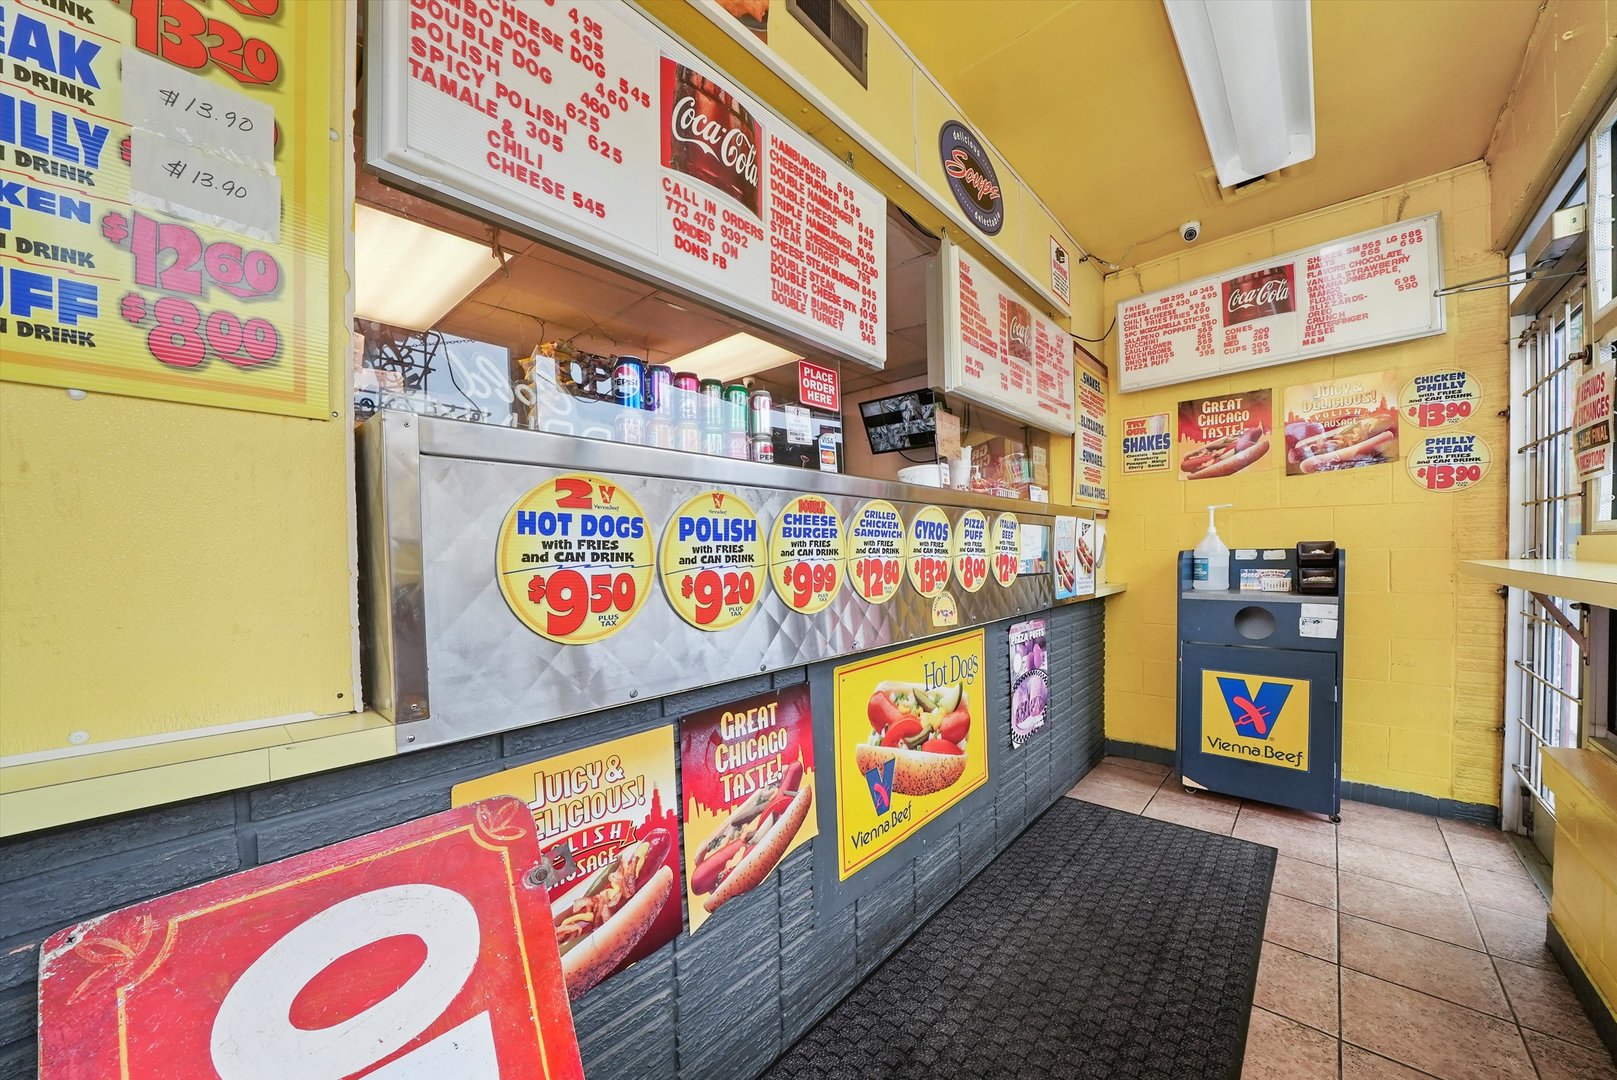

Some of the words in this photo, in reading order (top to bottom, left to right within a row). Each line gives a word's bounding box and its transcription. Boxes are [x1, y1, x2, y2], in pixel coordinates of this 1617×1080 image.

[568, 8, 602, 40] 495
[500, 20, 540, 57] DOG
[570, 28, 604, 59] 495
[411, 11, 500, 77] POLISH
[566, 102, 600, 132] 625
[513, 49, 552, 84] DOG
[13, 64, 95, 106] DRINK
[570, 45, 605, 78] DOG
[619, 78, 651, 108] 545
[408, 57, 498, 119] TAMALE
[526, 120, 563, 152] 305
[411, 36, 485, 88] SPICY
[496, 82, 567, 135] POLISH
[588, 134, 623, 164] 625
[159, 88, 253, 133] $13.90
[487, 130, 543, 170] CHILI
[15, 149, 96, 187] DRINK
[771, 134, 827, 182] HAMBURGER
[837, 182, 854, 200] 665
[945, 149, 1001, 201] Soups
[162, 160, 248, 200] $13.90
[487, 152, 565, 200] CHEESE
[572, 191, 606, 218] 545
[662, 177, 699, 207] CALL
[704, 200, 716, 216] IN
[722, 209, 764, 241] ORDERS
[770, 163, 805, 195] DOUBLE
[807, 187, 853, 226] HAMBURGER
[858, 222, 874, 239] 845
[771, 193, 802, 221] TRIPLE
[843, 200, 860, 218] 695
[665, 196, 688, 218] 773
[693, 211, 716, 231] 476
[721, 223, 748, 249] 9392
[771, 178, 805, 209] DOUBLE
[806, 202, 837, 229] CHEESE
[858, 235, 872, 250] 895
[673, 218, 712, 247] ORDER
[722, 241, 738, 259] ON
[1362, 240, 1381, 250] 565
[1400, 229, 1421, 240] 685
[1400, 236, 1423, 247] 695
[16, 237, 96, 269] DRINK
[674, 234, 708, 262] DONS
[712, 252, 727, 270] FB
[805, 239, 839, 268] BURGER
[770, 249, 807, 278] DOUBLE
[862, 298, 876, 313] 970
[770, 262, 807, 290] DOUBLE
[811, 283, 842, 307] CHEESE
[1309, 287, 1341, 299] MANGO
[771, 276, 808, 305] TURKEY
[811, 296, 844, 321] BURGER
[860, 320, 874, 335] 815
[1123, 309, 1150, 320] CHEESE
[1152, 303, 1174, 313] FRIES
[1125, 303, 1147, 313] FRIES
[1308, 308, 1332, 319] OREO
[772, 289, 807, 315] DOUBLE
[811, 307, 844, 331] TURKEY
[861, 331, 876, 346] 945
[1183, 313, 1210, 324] STICKS
[1305, 313, 1369, 332] BUTTERFINGER
[1306, 311, 1346, 325] CRUNCH
[17, 321, 97, 348] DRINK
[1162, 324, 1197, 336] POPPERS
[1225, 324, 1253, 336] CONES
[1304, 327, 1335, 338] RESEE
[1124, 341, 1172, 355] CAULIFLOWER
[1125, 347, 1172, 360] MUSHROOMS
[1224, 345, 1247, 355] CUPS
[1125, 357, 1148, 367] ONION
[1150, 352, 1175, 361] RINGS
[1125, 363, 1148, 372] PIZZA
[803, 367, 833, 383] PLACE
[1414, 372, 1466, 385] CHICKEN
[802, 379, 835, 395] ORDER
[1313, 384, 1351, 400] JUICY
[1416, 380, 1467, 393] PHILLY
[807, 391, 832, 405] HERE
[1202, 398, 1243, 414] GREAT
[1302, 390, 1377, 413] DELICIOUS!
[1198, 410, 1250, 427] CHICAGO
[1314, 408, 1362, 421] POLISH
[1126, 420, 1147, 428] TRY
[1200, 422, 1245, 439] TASTE!
[821, 437, 834, 445] VISA
[1123, 432, 1171, 454] SHAKES
[1425, 435, 1476, 446] PHILLY
[1591, 424, 1609, 445] FINAL
[1425, 444, 1474, 455] STEAK
[555, 478, 593, 509] 2
[798, 499, 827, 514] DOUBLE
[864, 510, 896, 520] GRILLED
[517, 511, 573, 536] HOT
[580, 514, 644, 539] DOGS
[783, 513, 836, 526] CHEESE
[859, 519, 899, 530] CHICKEN
[964, 518, 985, 529] PIZZA
[1000, 519, 1017, 530] ITALIAN
[678, 516, 757, 542] POLISH
[782, 526, 838, 539] BURGER
[854, 528, 902, 539] SANDWICH
[915, 520, 949, 541] GYROS
[964, 530, 983, 540] PUFF
[1002, 530, 1014, 539] BEEF
[541, 540, 571, 550] with
[577, 540, 619, 551] FRIES
[692, 545, 713, 554] with
[715, 544, 744, 554] FRIES
[780, 549, 795, 557] and
[797, 549, 814, 557] CAN
[816, 548, 839, 556] DRINK
[791, 540, 807, 548] with
[809, 540, 831, 548] FRIES
[521, 552, 549, 563] and
[554, 552, 585, 563] CAN
[591, 552, 635, 563] DRINK
[679, 556, 697, 565] and
[700, 555, 721, 564] CAN
[724, 554, 755, 564] DRINK
[598, 614, 619, 622] PLUS
[923, 659, 949, 692] Hot
[950, 654, 979, 686] Dogs
[719, 702, 779, 742] GREAT
[714, 726, 788, 775] CHICAGO
[1206, 735, 1261, 757] Vienna
[1264, 747, 1304, 766] Beef
[528, 759, 601, 811] JUICY
[604, 755, 626, 783] &
[719, 758, 784, 804] TASTE!
